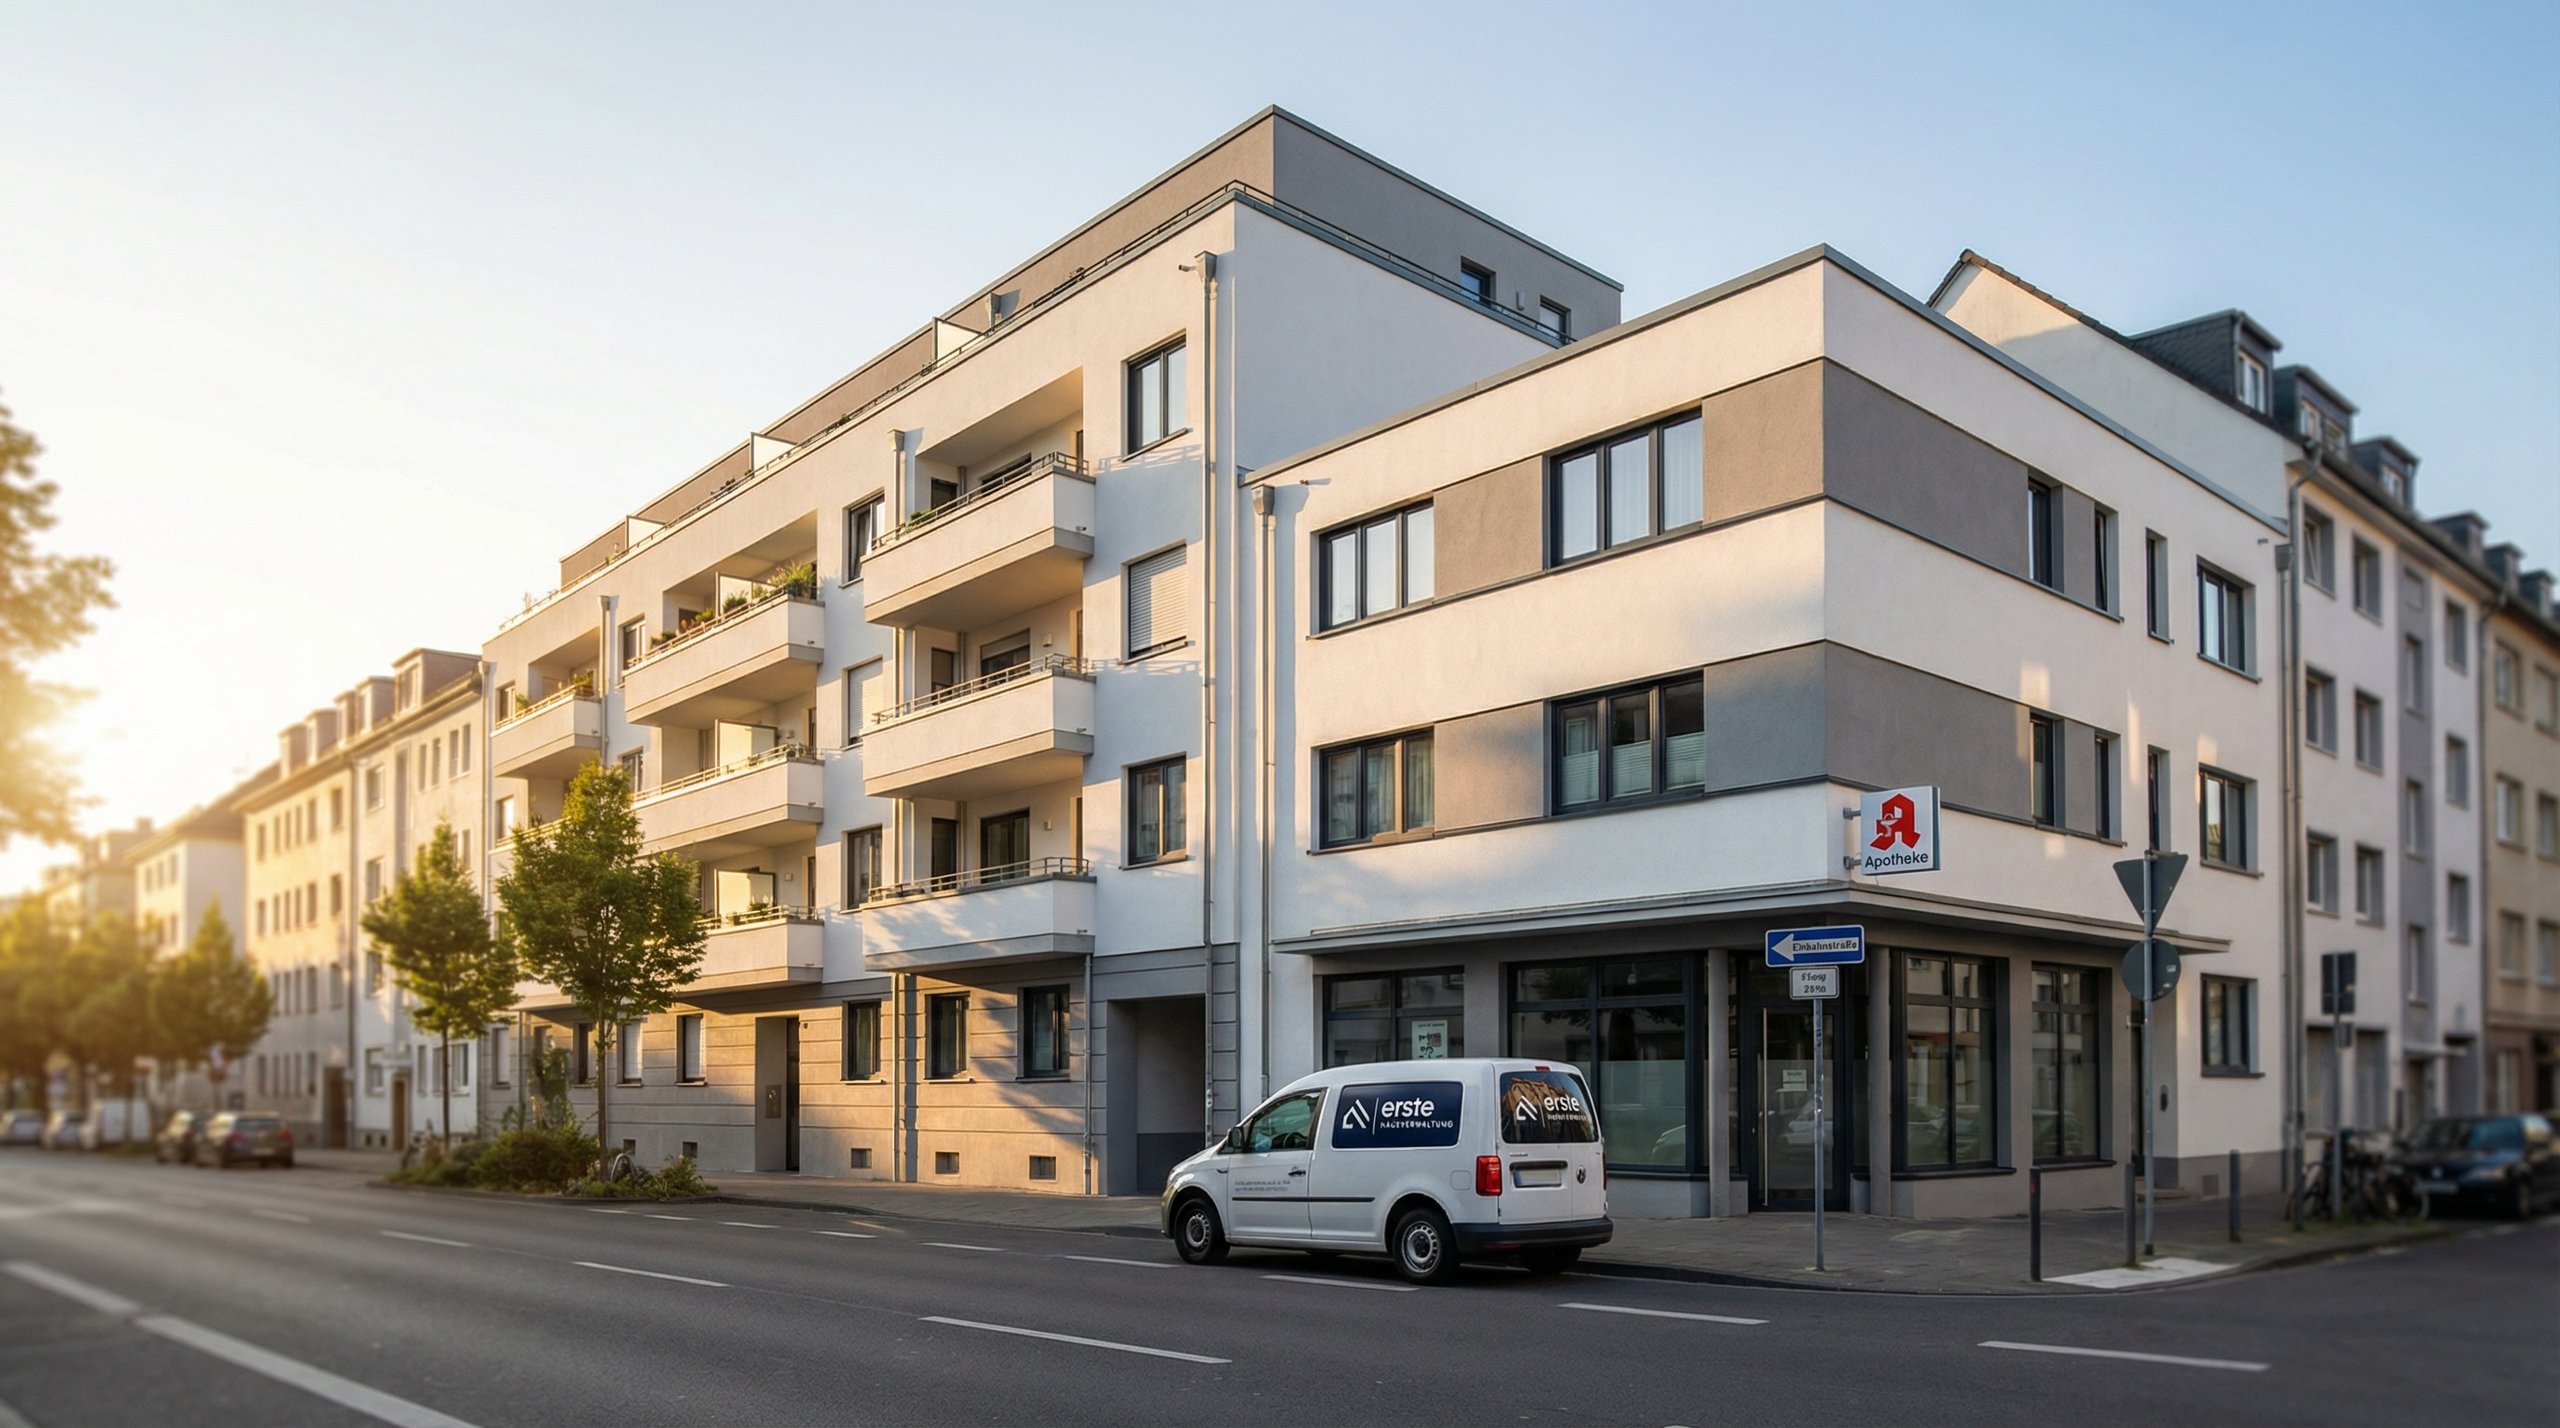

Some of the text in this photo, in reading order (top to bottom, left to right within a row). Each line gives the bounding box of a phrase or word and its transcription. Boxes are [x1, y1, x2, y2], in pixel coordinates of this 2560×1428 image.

[1865, 851, 1928, 870] Apotheke
[1381, 1097, 1434, 1117] erste
[1544, 1093, 1580, 1112] erste
